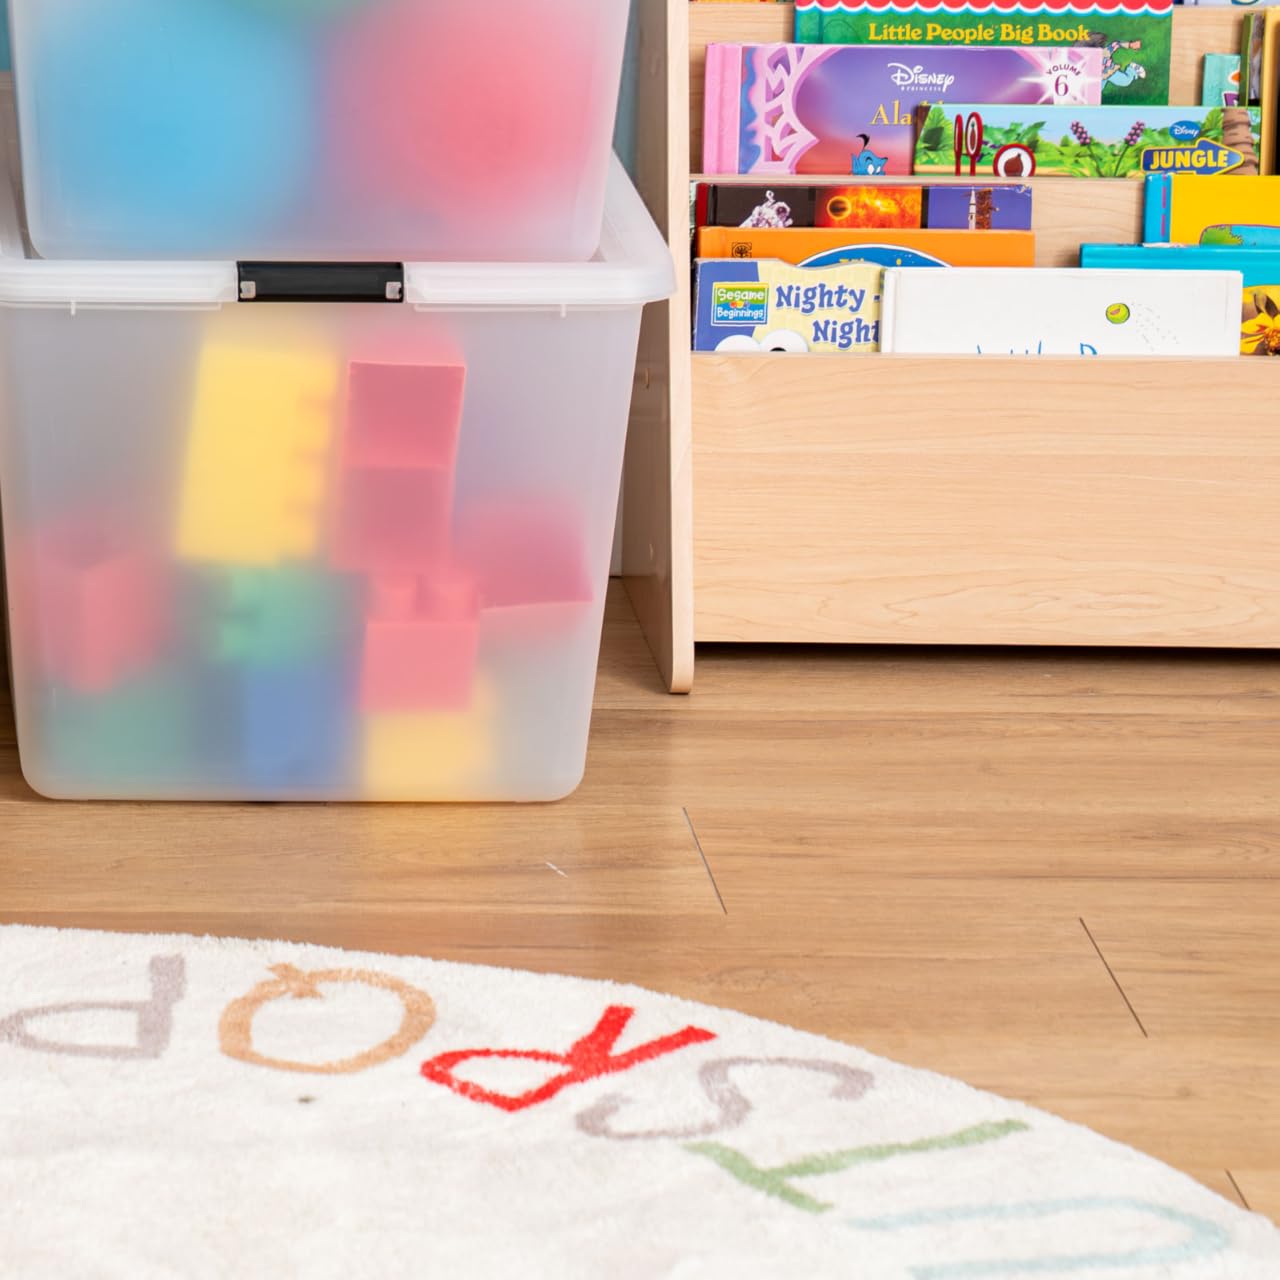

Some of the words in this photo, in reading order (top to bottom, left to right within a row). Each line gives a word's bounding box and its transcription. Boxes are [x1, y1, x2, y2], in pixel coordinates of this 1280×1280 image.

[869, 23, 923, 42] Little
[926, 23, 995, 45] People
[999, 23, 1034, 45] Big
[1037, 23, 1091, 42] Book
[1045, 63, 1083, 77] VOLUME
[1054, 74, 1070, 97] 6
[1150, 149, 1229, 170] JUNGLE
[717, 287, 765, 301] Sesame
[775, 283, 866, 314] Nighty
[717, 306, 764, 320] Beginnings
